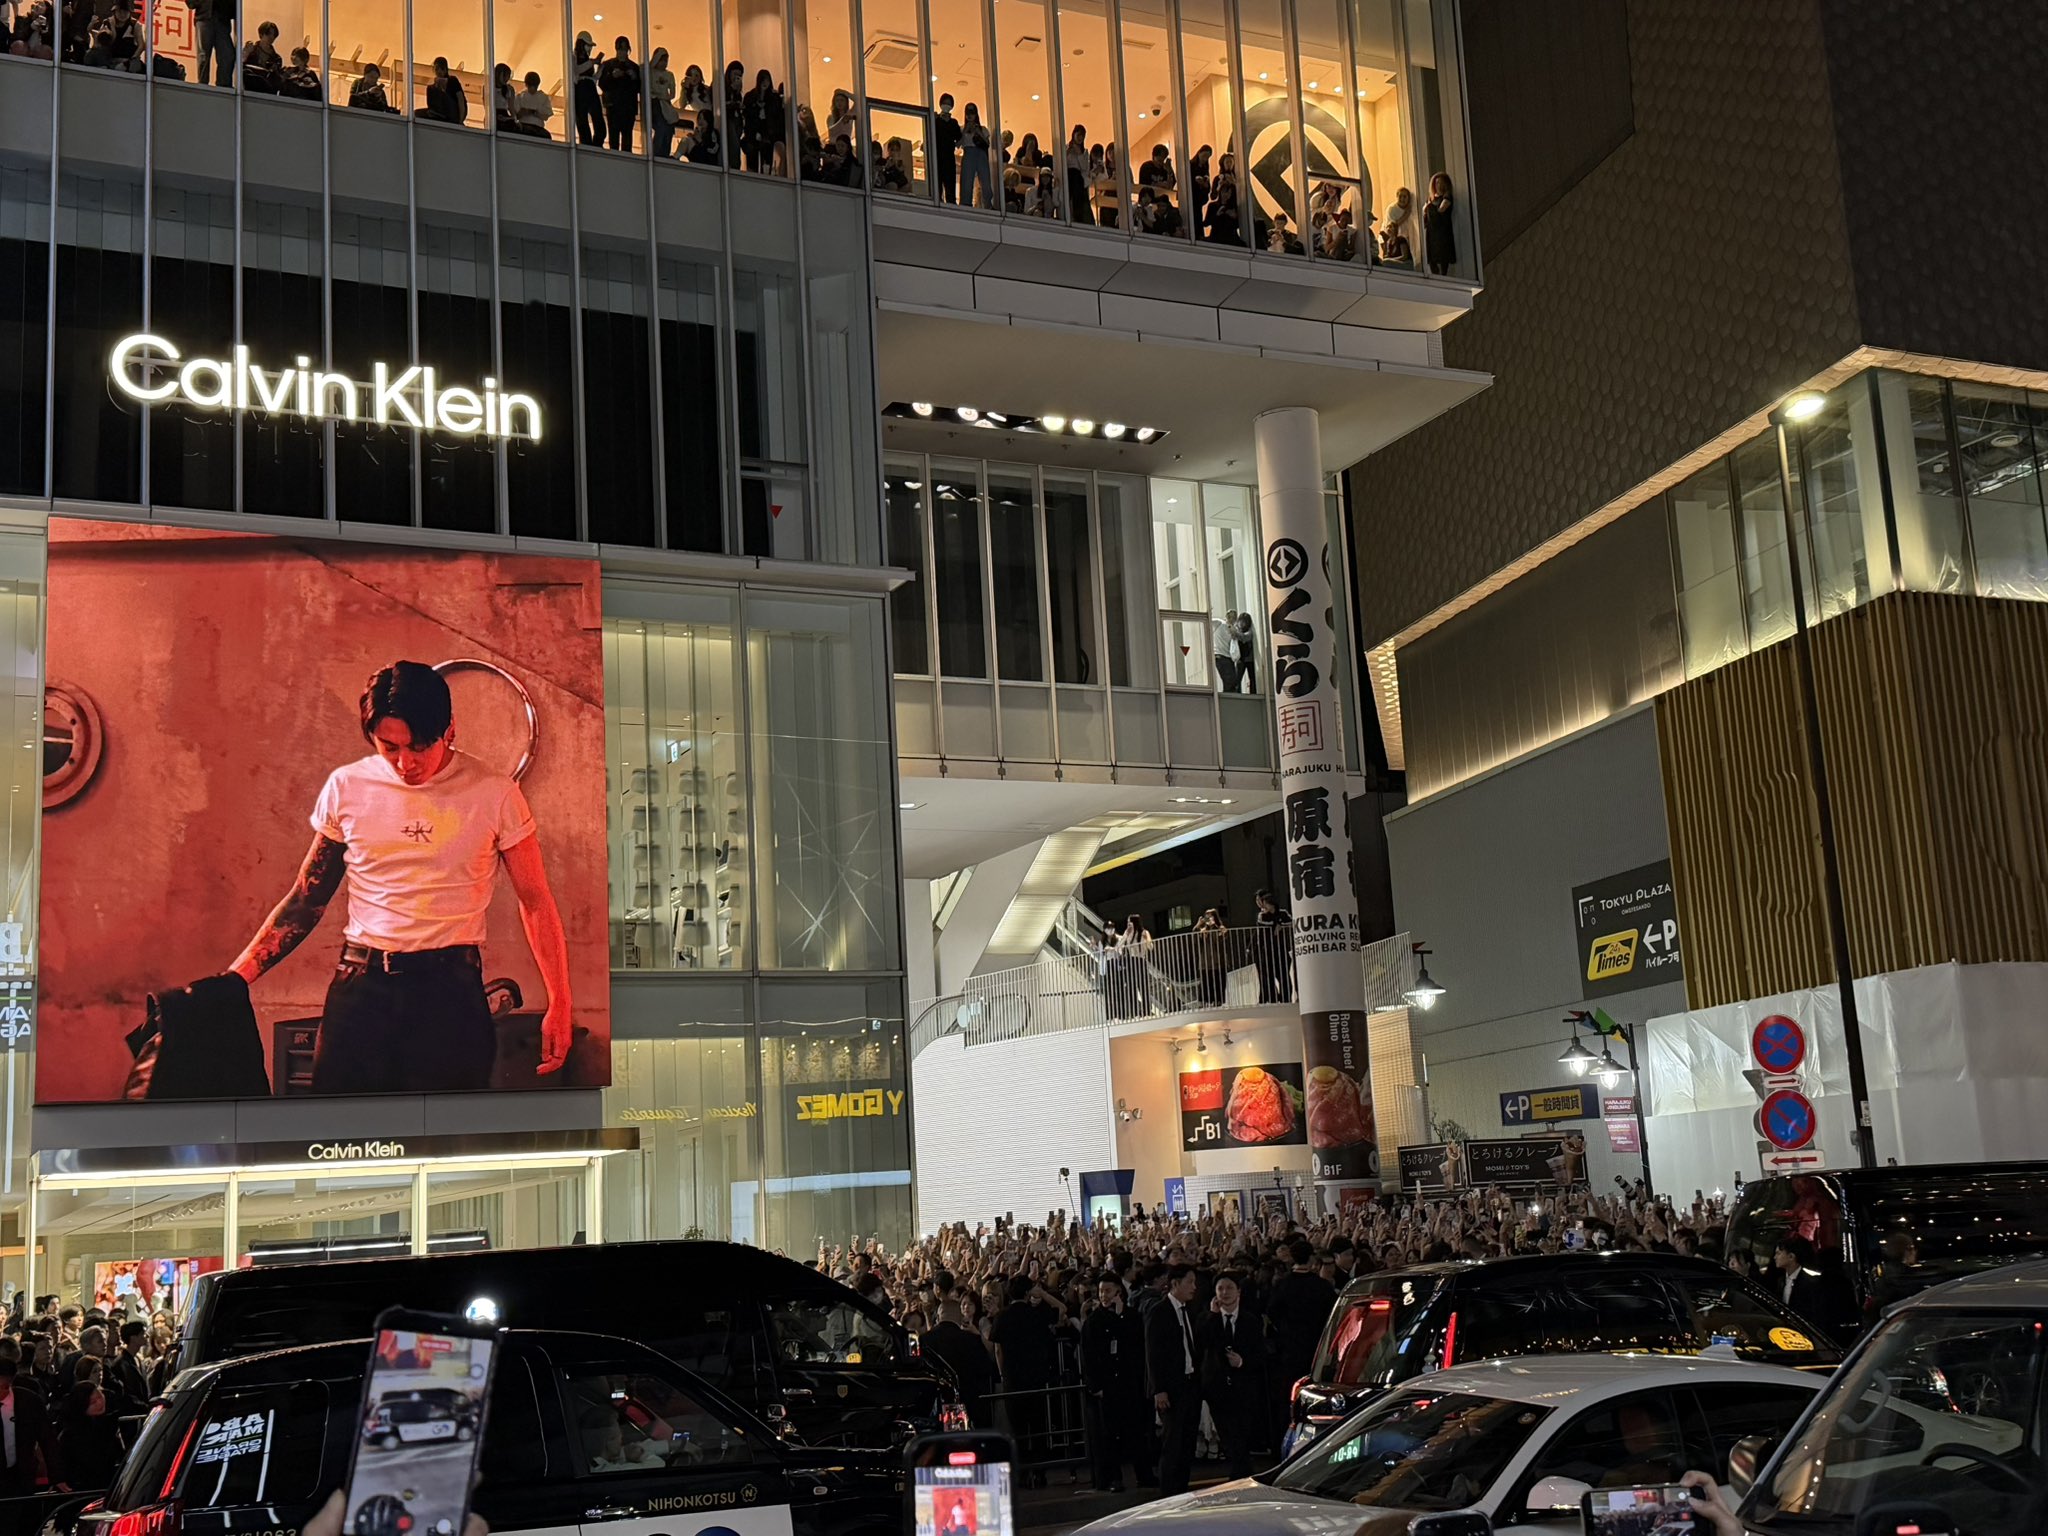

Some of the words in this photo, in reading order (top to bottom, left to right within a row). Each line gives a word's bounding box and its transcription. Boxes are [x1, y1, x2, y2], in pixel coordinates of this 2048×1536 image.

[110, 333, 358, 421] Calvin
[375, 361, 542, 440] Klein
[1271, 586, 1319, 698] くら
[1286, 786, 1335, 901] 原宿
[1600, 894, 1632, 910] TOKYU
[1636, 884, 1671, 901] PLAZA
[1663, 919, 1677, 951] P
[1322, 943, 1347, 955] BAR
[1596, 950, 1631, 973] Times
[1329, 1014, 1339, 1042] Ohno
[1341, 1013, 1351, 1044] Roast
[1343, 1045, 1355, 1070] beef
[1517, 1095, 1530, 1121] P
[1206, 1122, 1221, 1140] B1
[307, 1143, 362, 1160] Calvin
[364, 1142, 405, 1157] Klein
[1323, 1164, 1342, 1176] B1F
[648, 1491, 736, 1511] NIHONKOTSU
